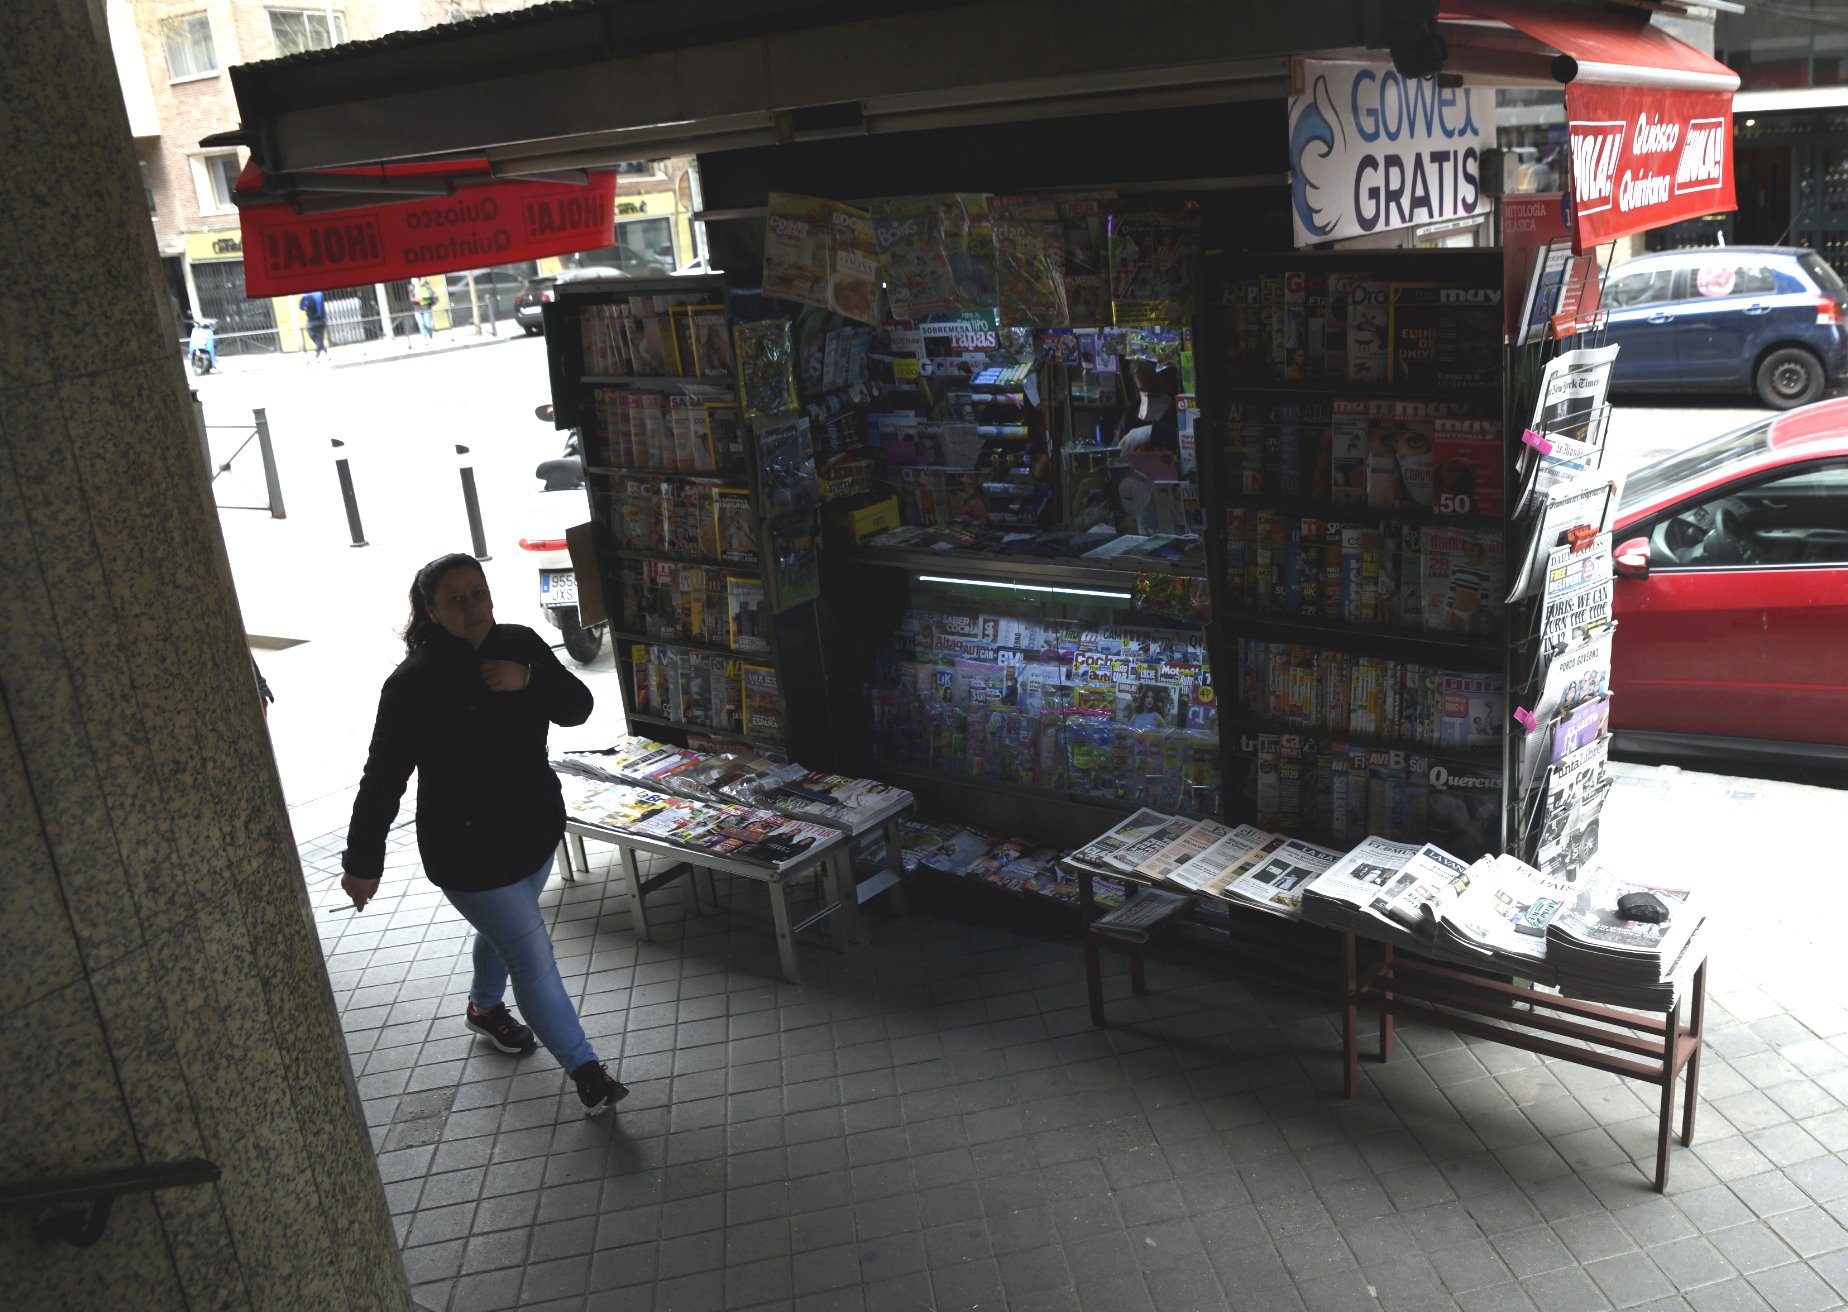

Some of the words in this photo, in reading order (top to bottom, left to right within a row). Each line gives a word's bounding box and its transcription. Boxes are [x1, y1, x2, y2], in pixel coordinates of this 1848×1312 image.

[1633, 112, 1680, 157] Quiosco
[1354, 148, 1480, 234] GRATIS
[1619, 168, 1671, 214] Quintana
[922, 325, 971, 335] SOBREMESA
[1578, 378, 1600, 389] Times
[1429, 557, 1450, 571] 28
[552, 588, 573, 601] JXS
[1577, 593, 1591, 610] WE
[1593, 586, 1608, 605] CAN
[942, 614, 970, 625] SABER
[1570, 610, 1586, 627] THE
[1429, 766, 1503, 790] Quercus
[1430, 851, 1442, 862] LA
